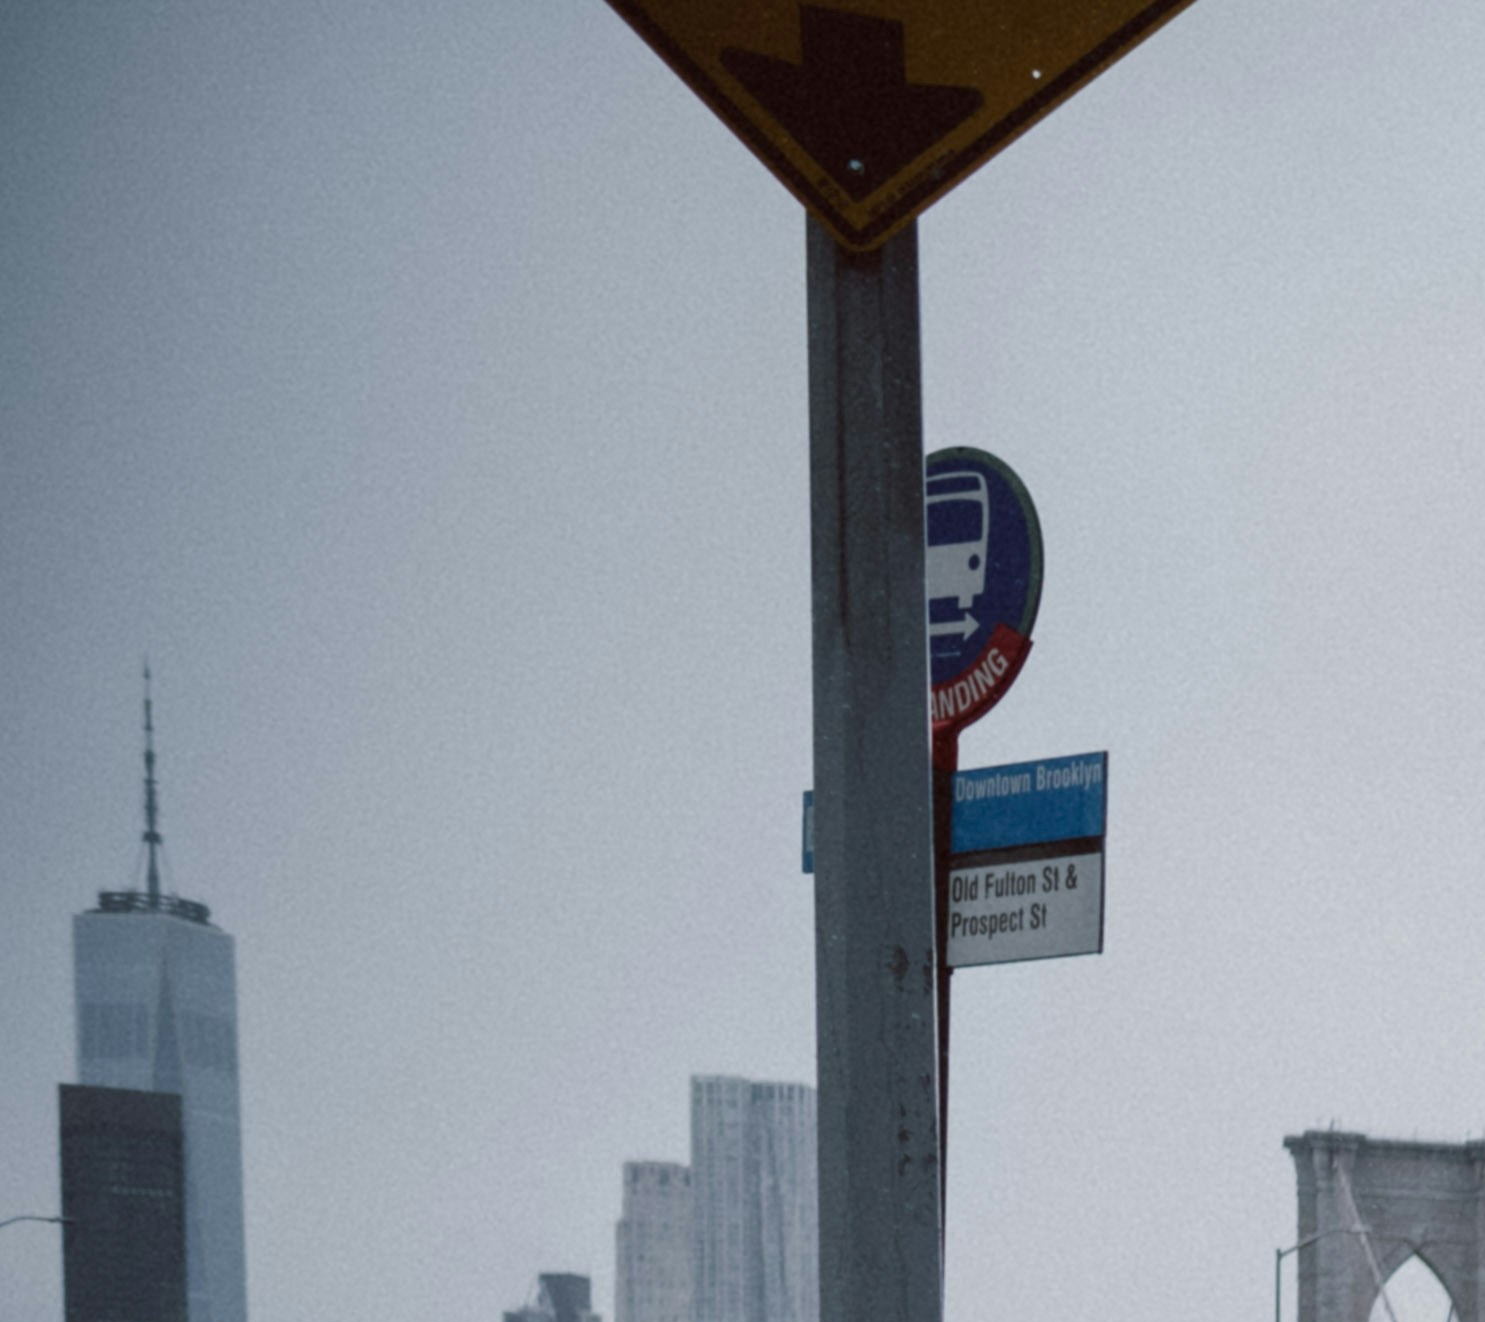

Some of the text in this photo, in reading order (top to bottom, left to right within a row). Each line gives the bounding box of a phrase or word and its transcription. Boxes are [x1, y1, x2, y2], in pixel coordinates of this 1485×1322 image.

[931, 648, 1008, 721] ANDING
[956, 762, 1101, 803] Downtown Brooklyn
[952, 864, 1077, 903] Old Fulton St &
[951, 903, 1047, 940] Prospect St
